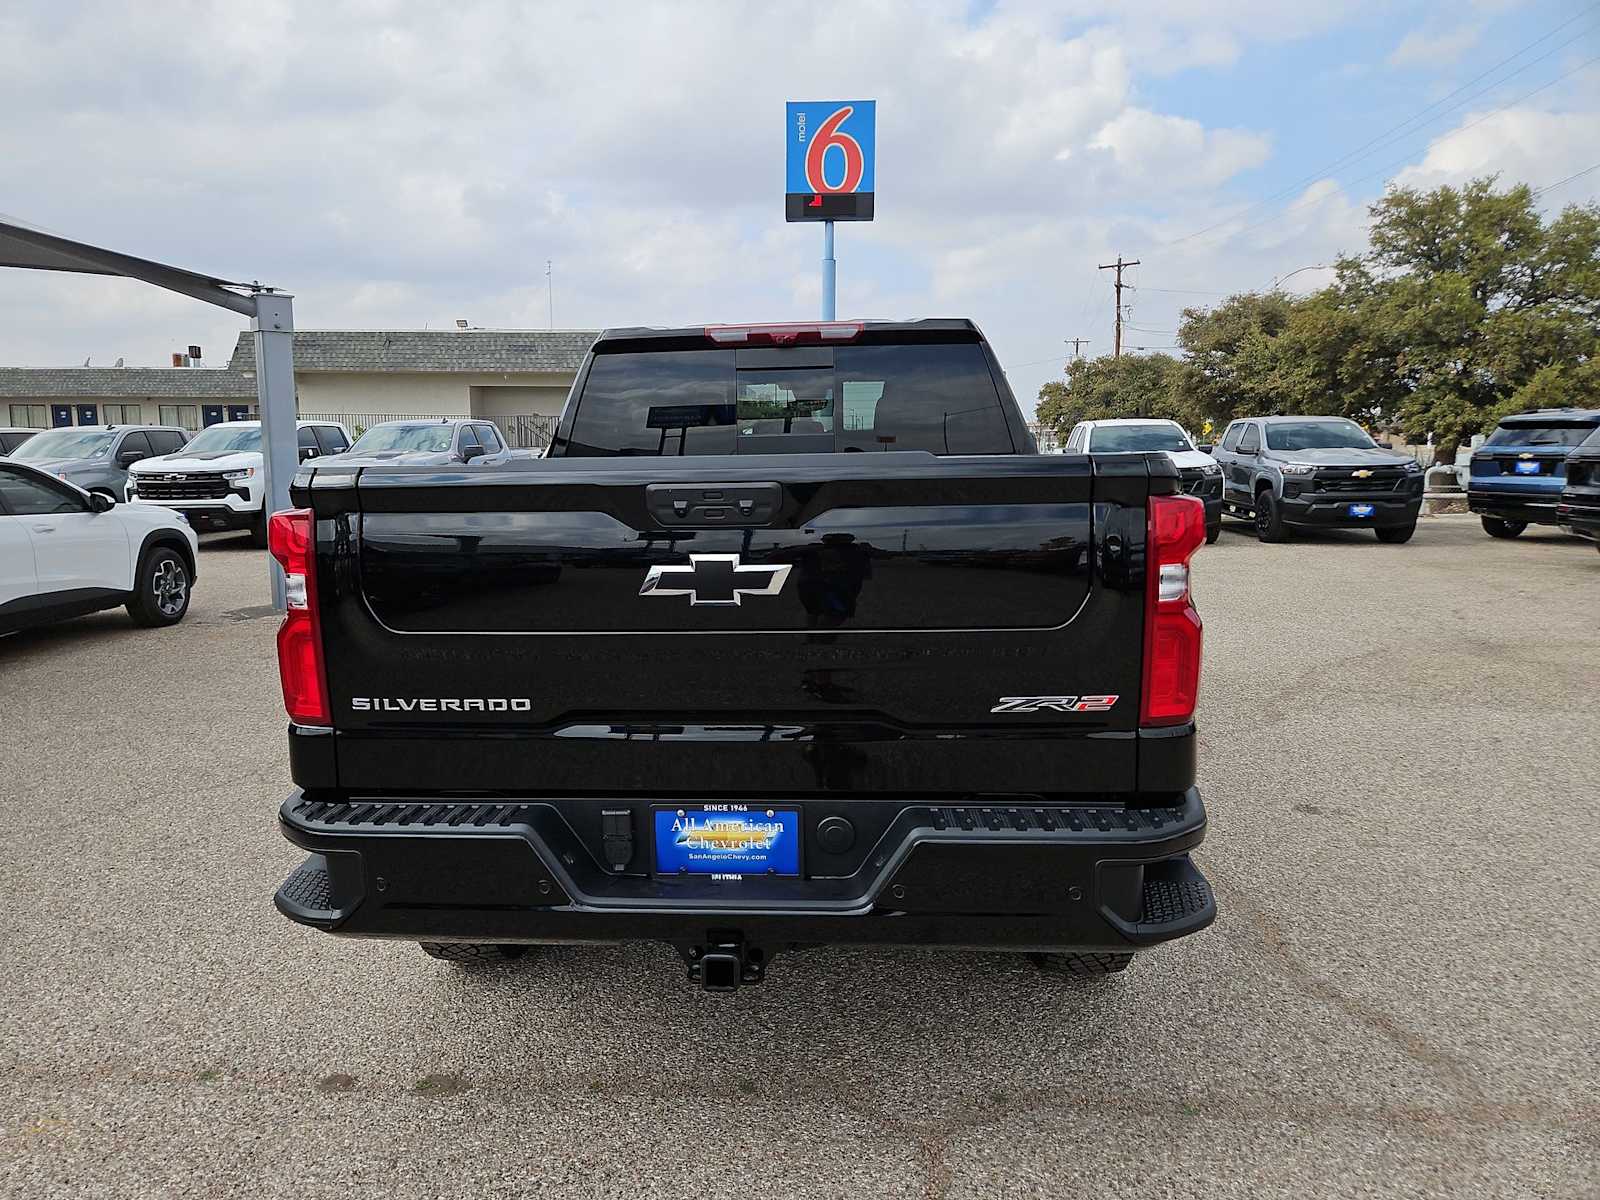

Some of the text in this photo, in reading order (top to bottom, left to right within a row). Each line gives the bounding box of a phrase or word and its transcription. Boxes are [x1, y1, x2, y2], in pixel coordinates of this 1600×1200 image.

[797, 112, 806, 142] motel
[805, 105, 864, 193] 6
[352, 697, 531, 711] SILVERADO
[990, 695, 1119, 712] ZR2
[703, 804, 729, 812] SINCE
[671, 817, 784, 833] All American
[686, 836, 772, 850] Chevrolet
[688, 853, 767, 861] SanAngeloChevy.com
